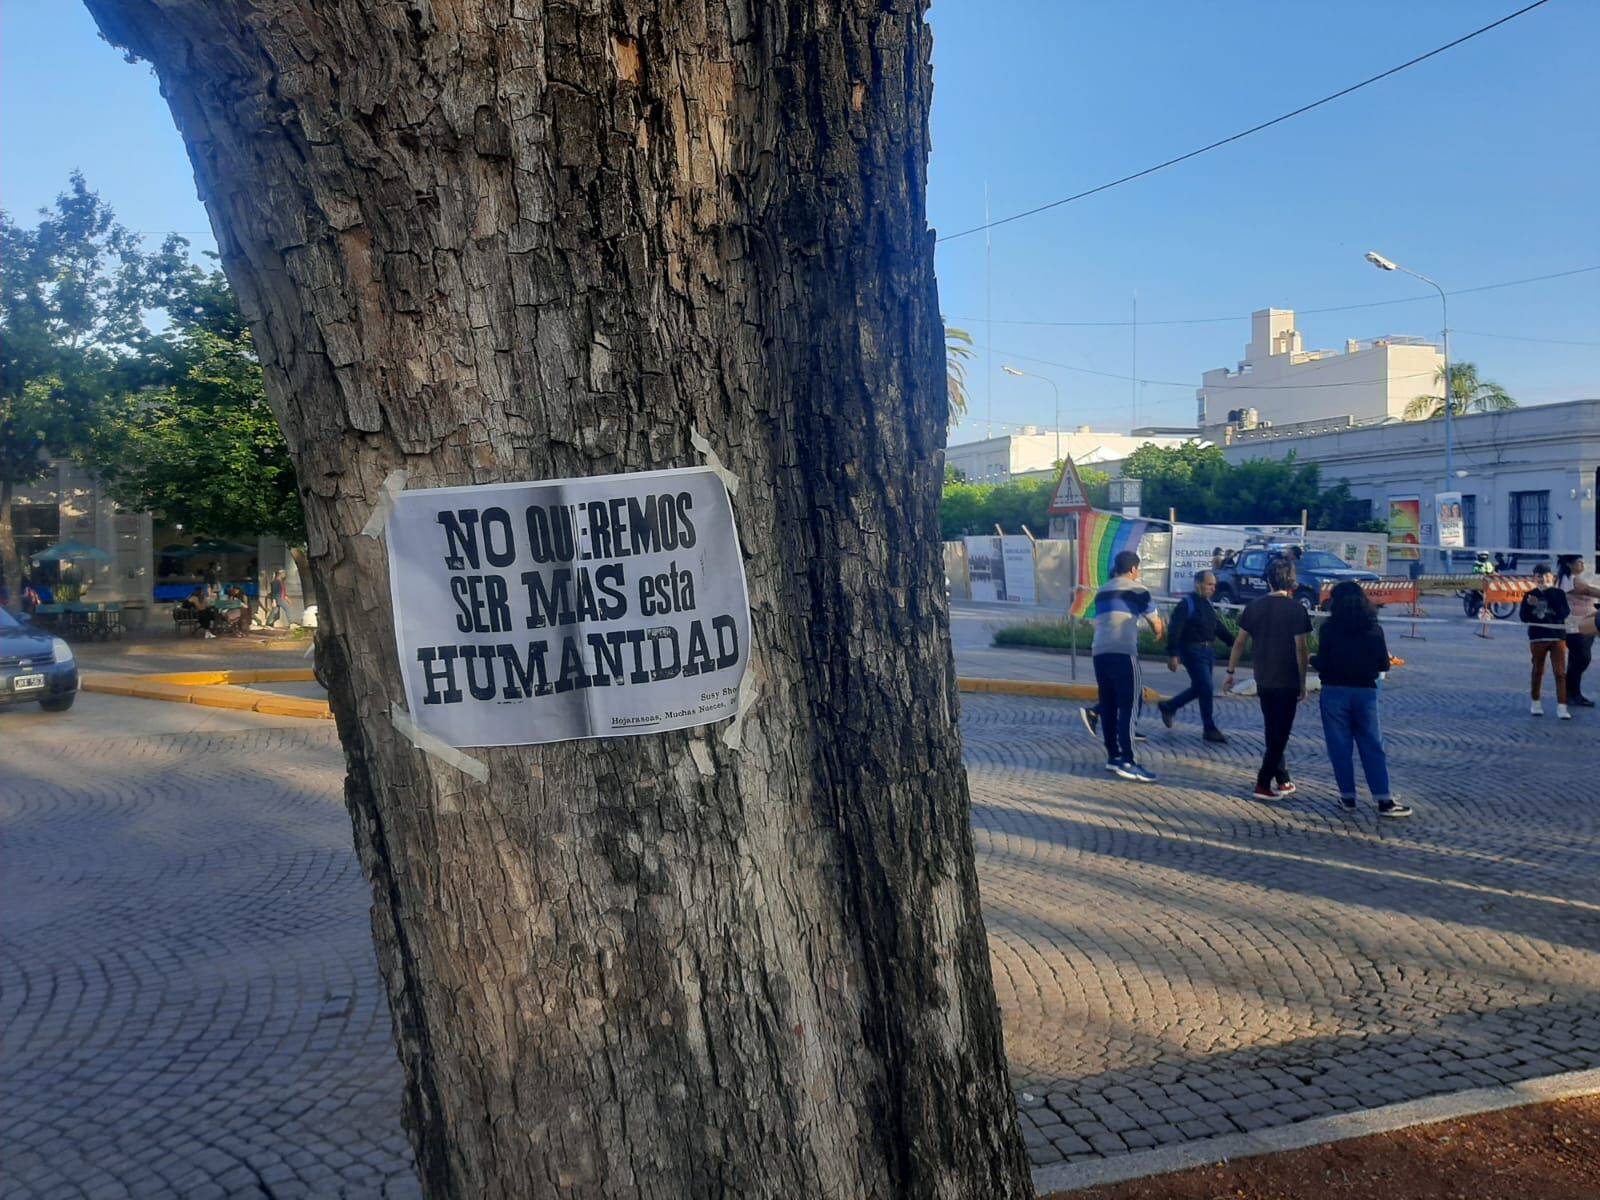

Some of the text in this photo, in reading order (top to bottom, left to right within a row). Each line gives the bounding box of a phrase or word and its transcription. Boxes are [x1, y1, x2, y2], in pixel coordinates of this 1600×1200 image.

[437, 491, 697, 570] NO QUEREMOS
[1175, 550, 1213, 558] REMODEL
[450, 560, 697, 634] SER MAS esta
[417, 614, 740, 705] HUMANIDAD
[665, 709, 696, 720] Muchas
[700, 691, 720, 701] Susy
[722, 687, 738, 696] Sho
